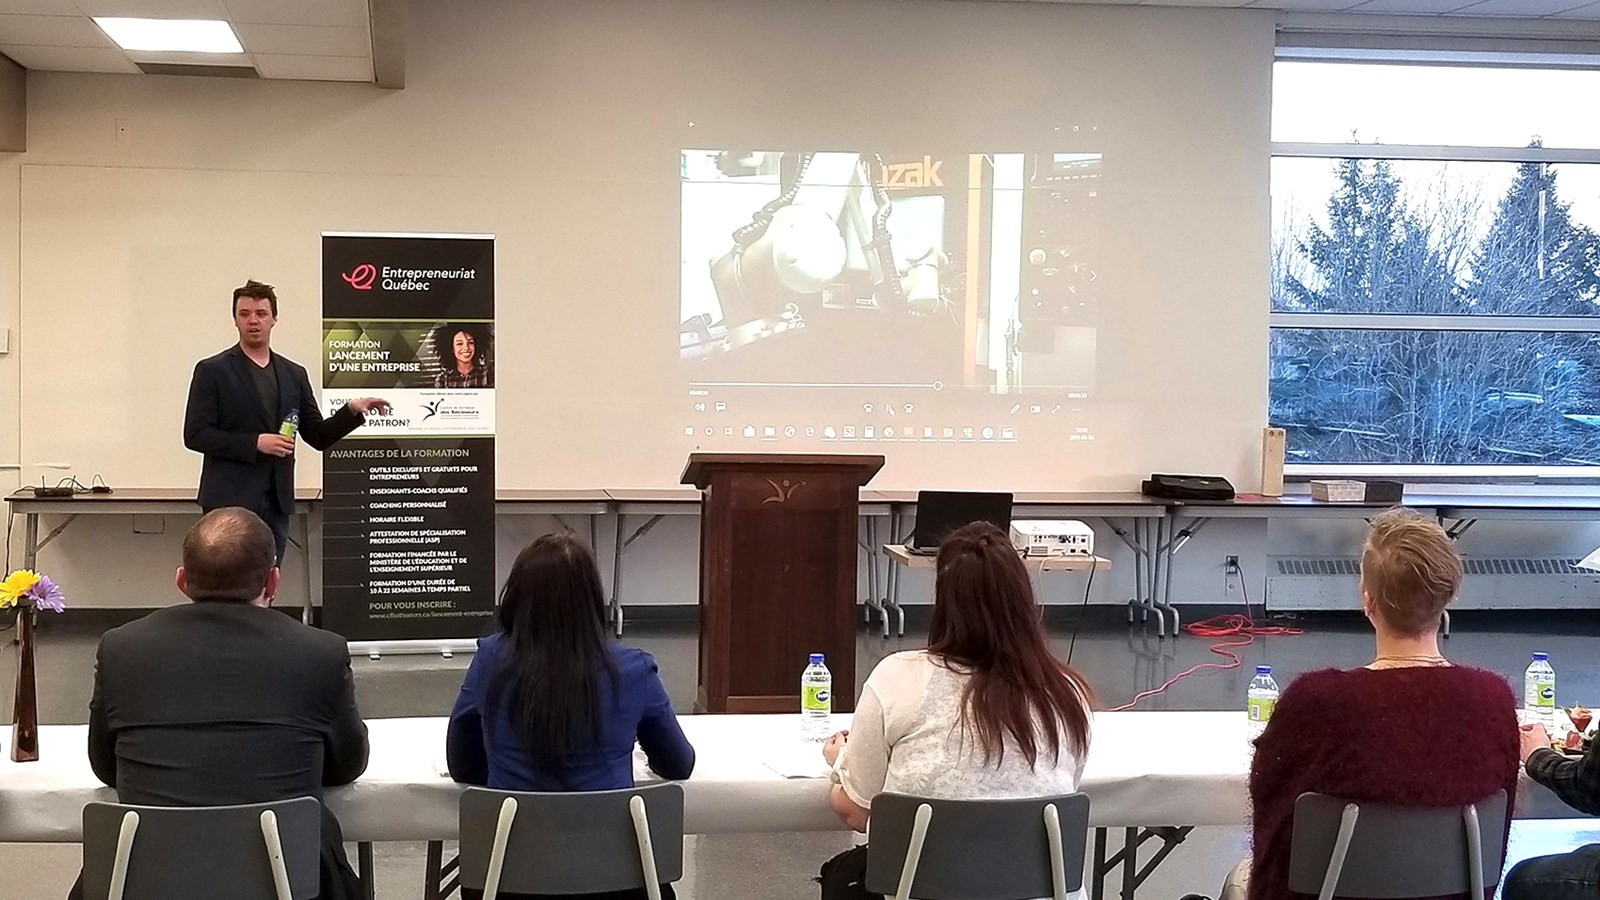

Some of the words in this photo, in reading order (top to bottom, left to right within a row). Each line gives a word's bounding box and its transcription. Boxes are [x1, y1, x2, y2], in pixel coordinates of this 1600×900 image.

[381, 266, 476, 281] Entrepreneuriat
[381, 278, 430, 291] Québec
[328, 340, 381, 349] FORMATION
[328, 351, 391, 360] LANCEMENT
[329, 363, 360, 372] D'UNE
[361, 363, 421, 372] ENTREPRISE
[368, 419, 411, 427] PATRON?
[330, 450, 385, 458] AVANTAGES
[386, 450, 399, 458] DE
[401, 449, 413, 458] LA
[414, 449, 470, 457] FORMATION
[437, 486, 468, 494] QUALIFIÉS
[369, 602, 393, 610] POUR
[394, 601, 416, 609] VOUS
[416, 600, 452, 608] INSCRIRE
